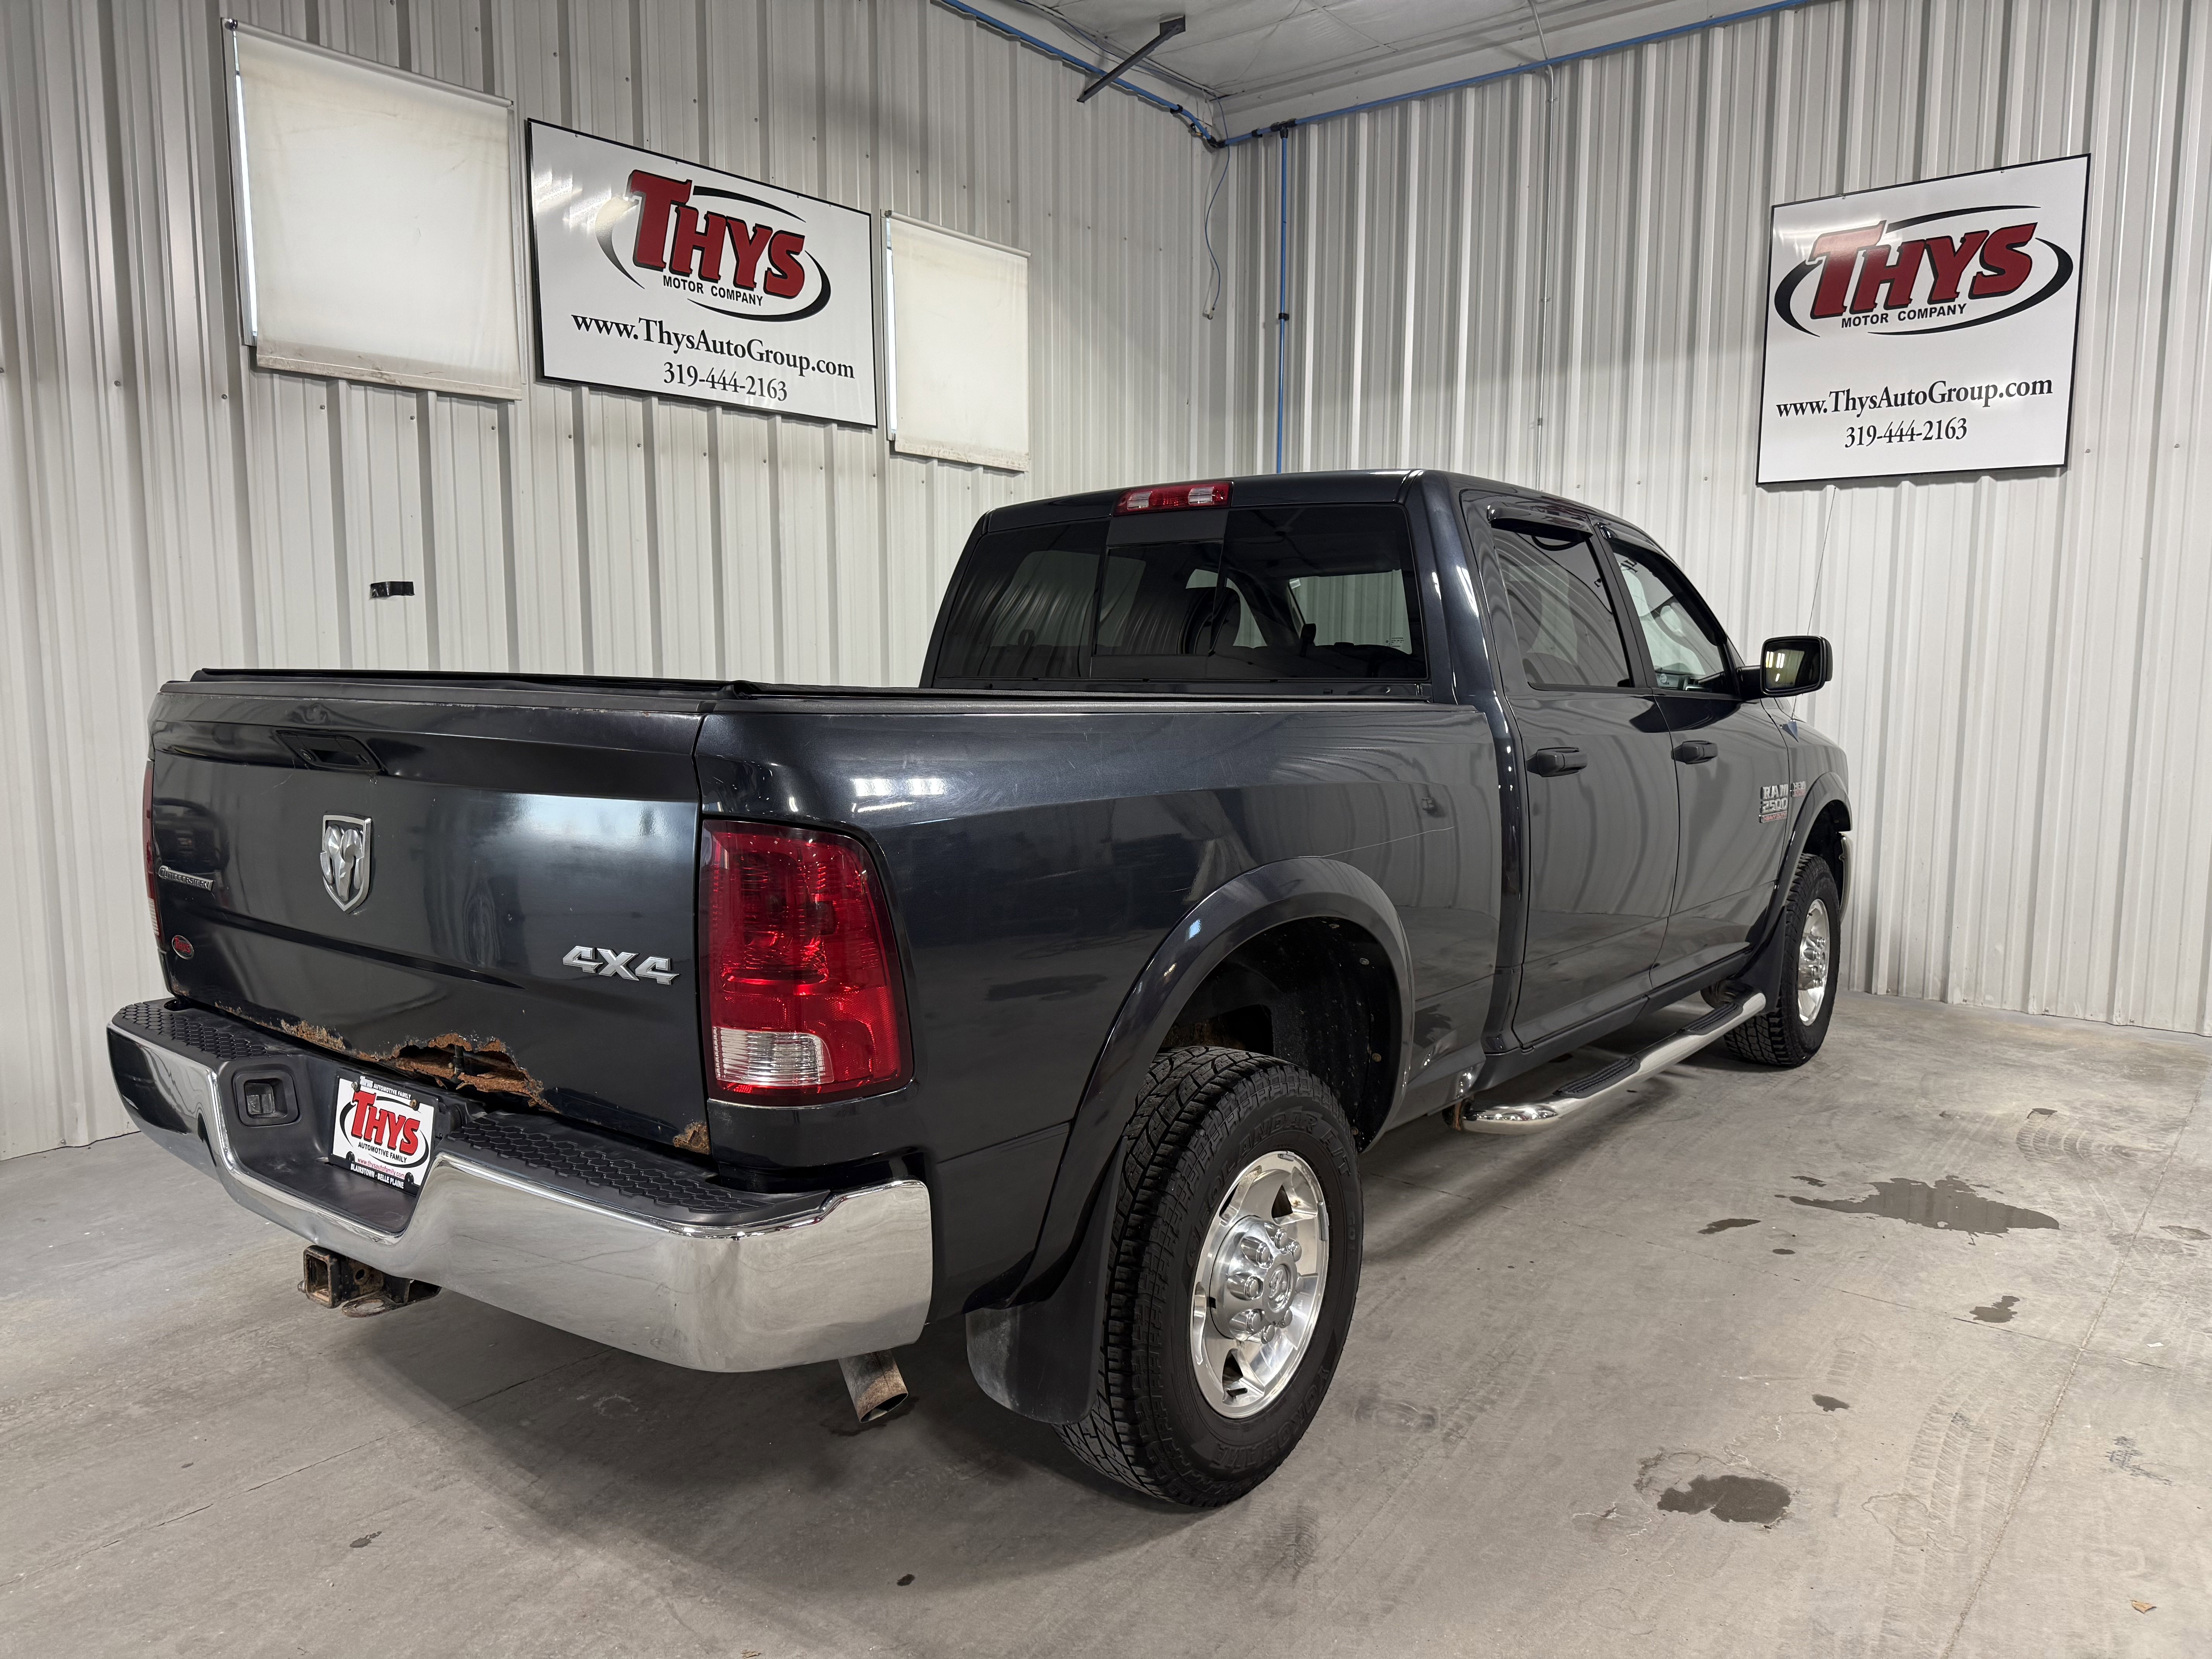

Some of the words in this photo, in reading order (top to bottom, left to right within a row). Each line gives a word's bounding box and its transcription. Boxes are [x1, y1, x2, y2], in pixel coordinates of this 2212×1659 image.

[624, 169, 805, 300] THYS
[1808, 220, 2038, 320] THYS
[663, 275, 704, 294] MOTOR
[710, 285, 763, 306] COMPANY
[1841, 313, 1889, 329] MOTOR
[1898, 303, 1967, 322] COMPANY
[571, 314, 855, 379] www.ThysAutoGroup.com
[663, 361, 788, 402] 319-444-2163
[1776, 378, 2053, 418] www.ThysAutoGroup.com
[1844, 416, 1968, 448] 319-444-2163
[1762, 783, 1789, 800] RAM
[1762, 797, 1788, 814] 2500
[373, 1083, 397, 1095] AUTOMOTIVE
[397, 1091, 411, 1099] FAMILY
[351, 1090, 421, 1156] THYS
[358, 1141, 389, 1157] AUTOMOTIVE
[390, 1152, 407, 1163] FAMILY
[350, 1163, 375, 1178] BLAIRSTOWN
[377, 1173, 390, 1183] BELLE
[390, 1177, 404, 1189] PLAINE
